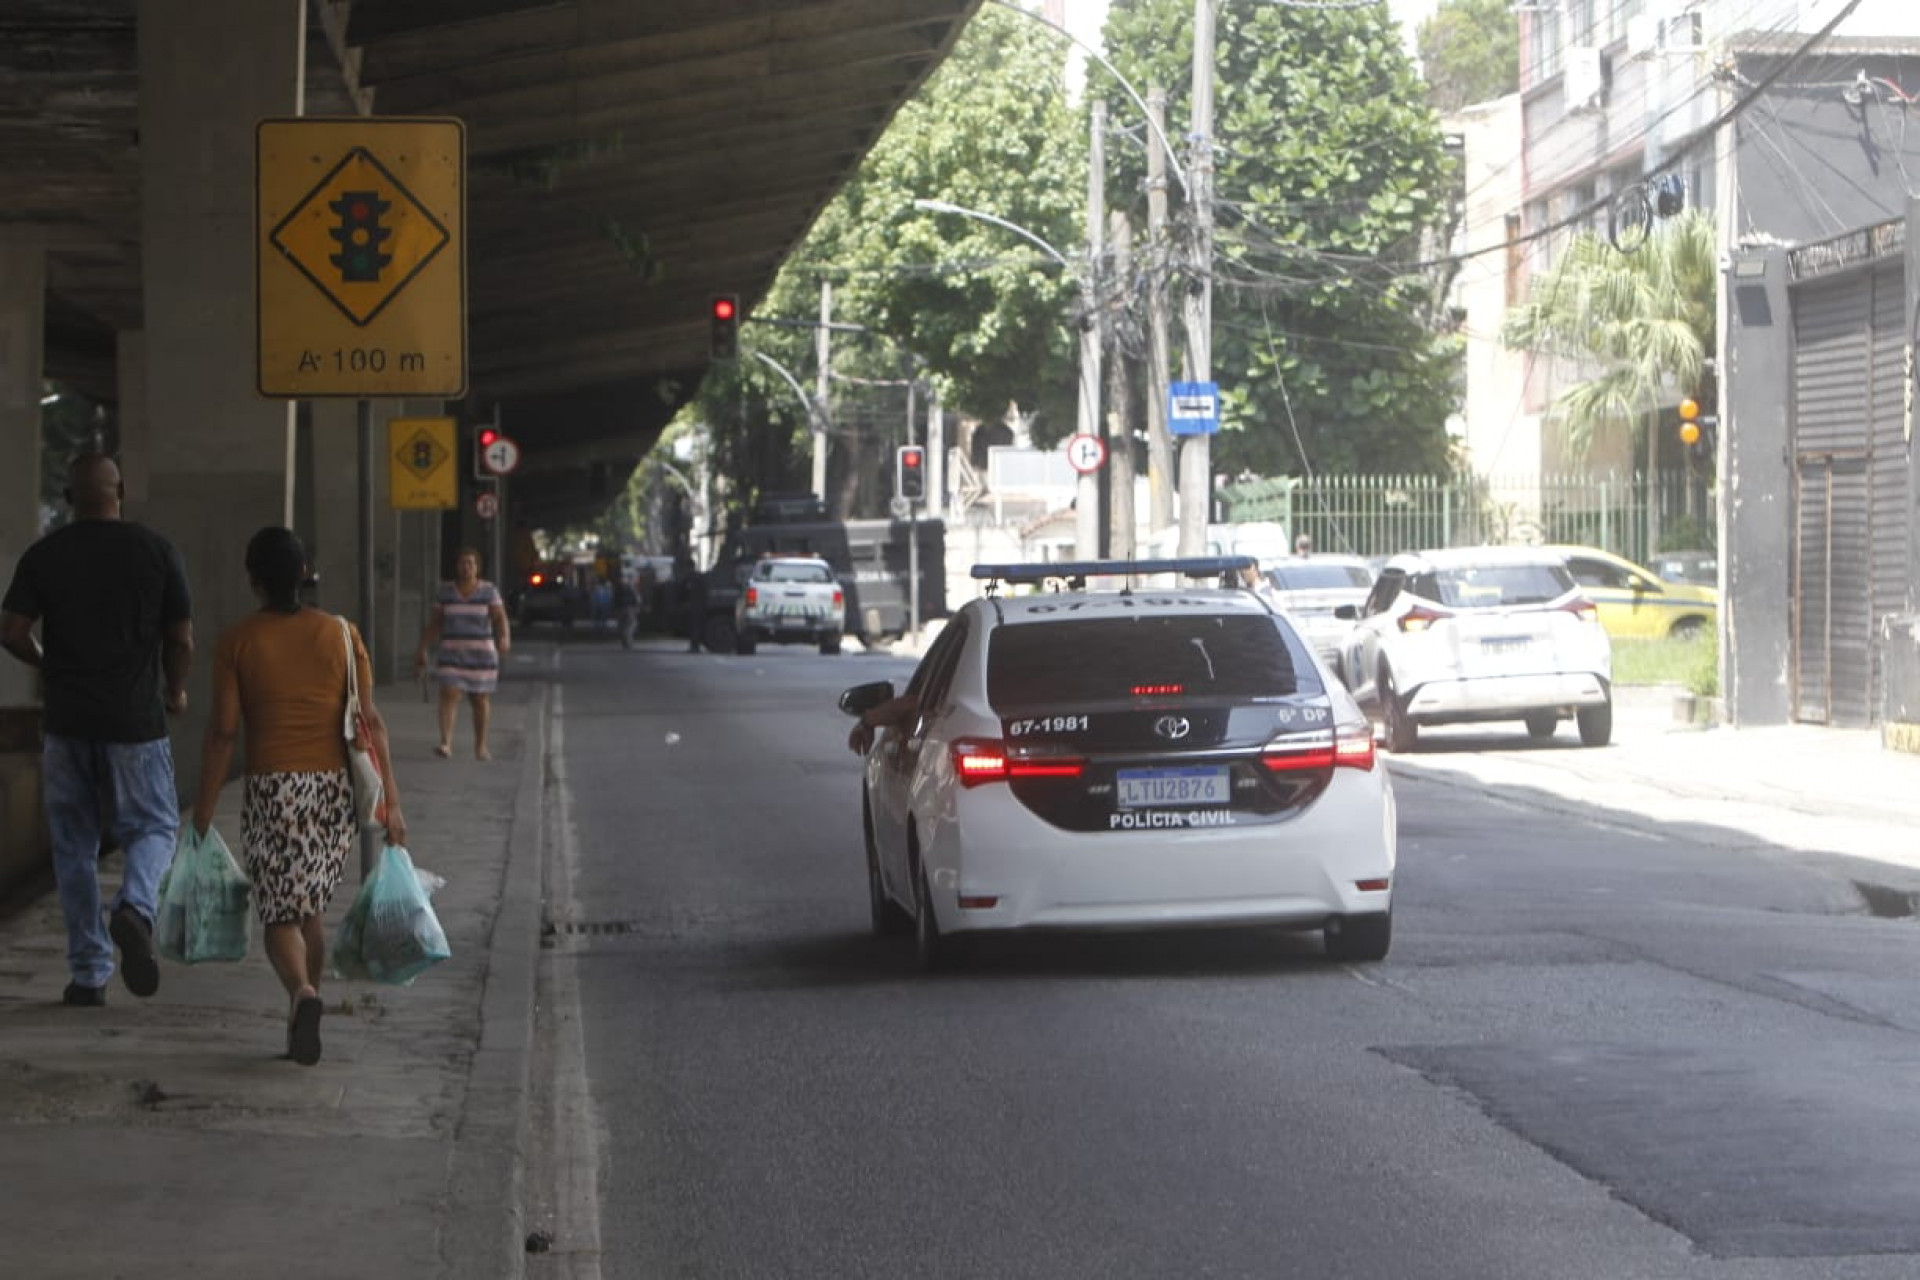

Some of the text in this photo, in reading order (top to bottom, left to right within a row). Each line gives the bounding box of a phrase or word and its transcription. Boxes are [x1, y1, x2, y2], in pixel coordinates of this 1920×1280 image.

[298, 347, 426, 373] A 100 m
[1302, 708, 1328, 721] DP
[1009, 715, 1088, 736] 67-1981
[1126, 778, 1216, 801] LTU2B76
[1109, 809, 1237, 829] POLÍCIA CIVIL
